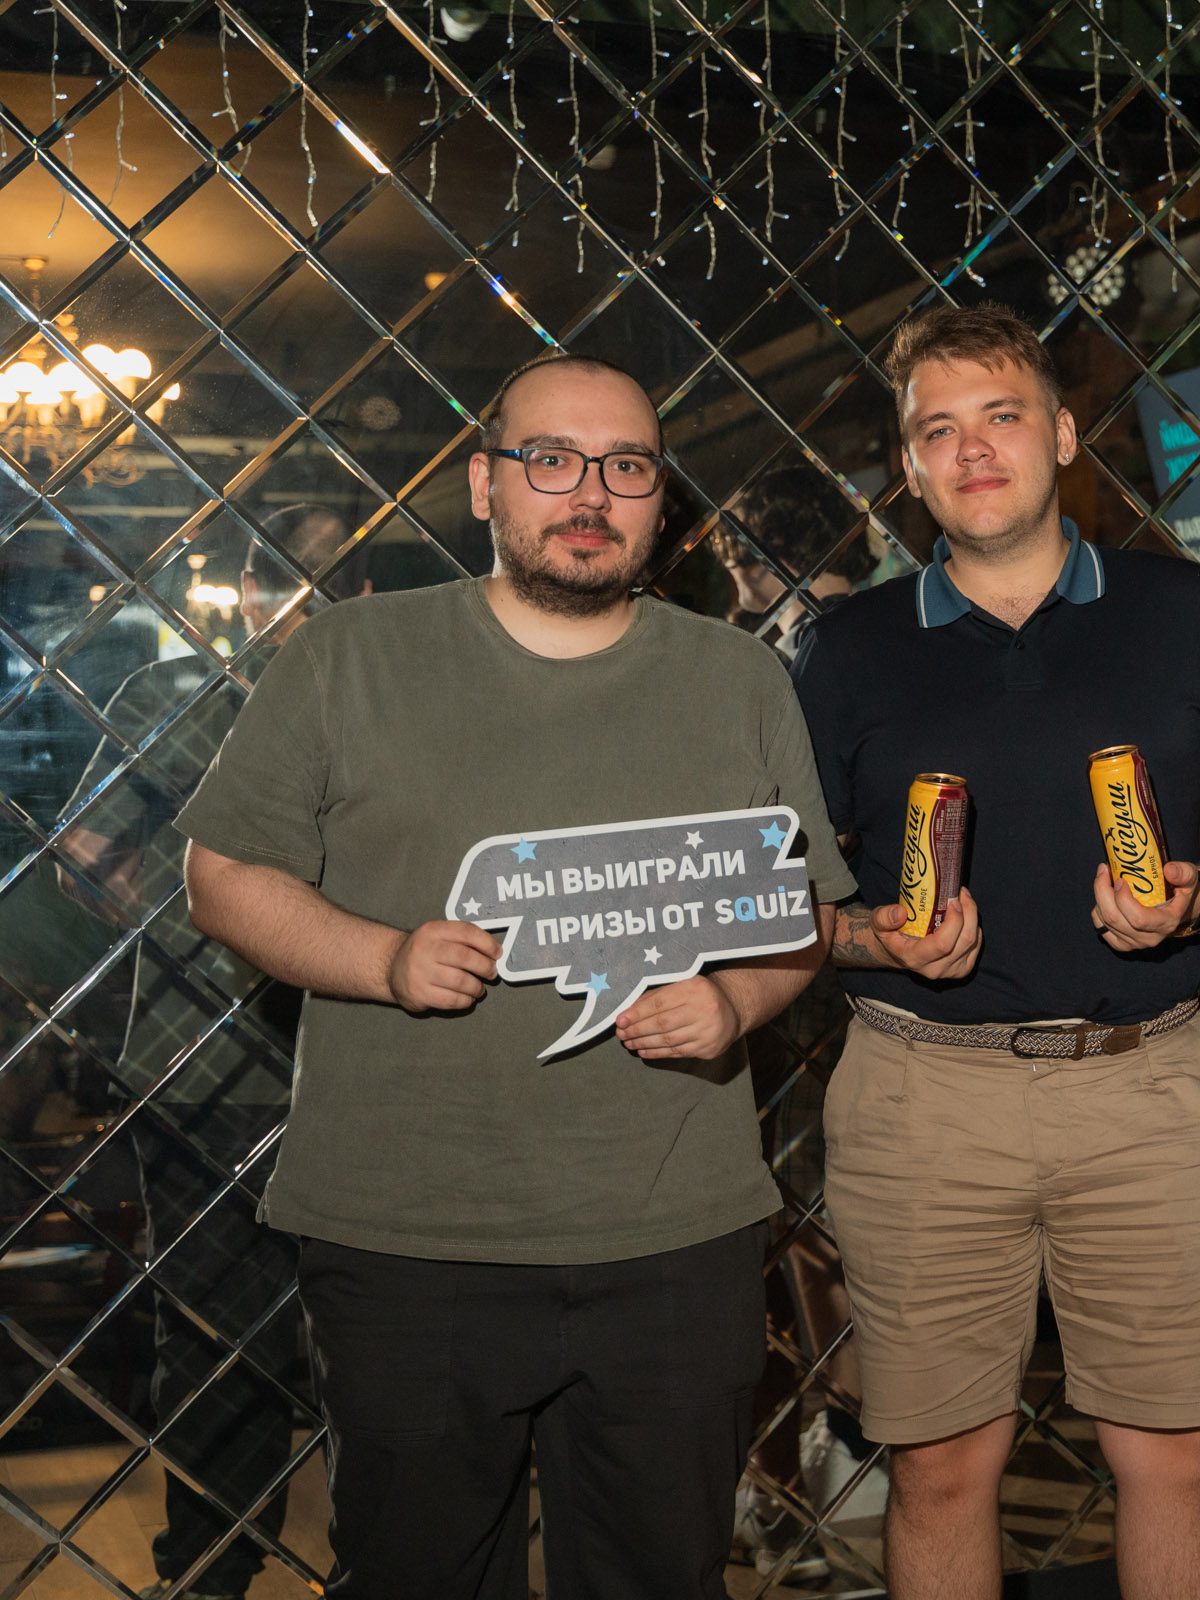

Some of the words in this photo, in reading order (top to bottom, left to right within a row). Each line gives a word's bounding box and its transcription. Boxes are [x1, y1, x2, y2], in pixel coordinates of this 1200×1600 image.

[1108, 781, 1153, 894] Жигули
[496, 870, 555, 901] МЫ
[562, 849, 746, 895] ВЫИГРАЛИ
[1149, 855, 1158, 879] БАРНОЕ
[918, 887, 928, 912] БАРНОЕ
[536, 907, 656, 946] ПРИЗЫ
[662, 901, 704, 930] ОТ
